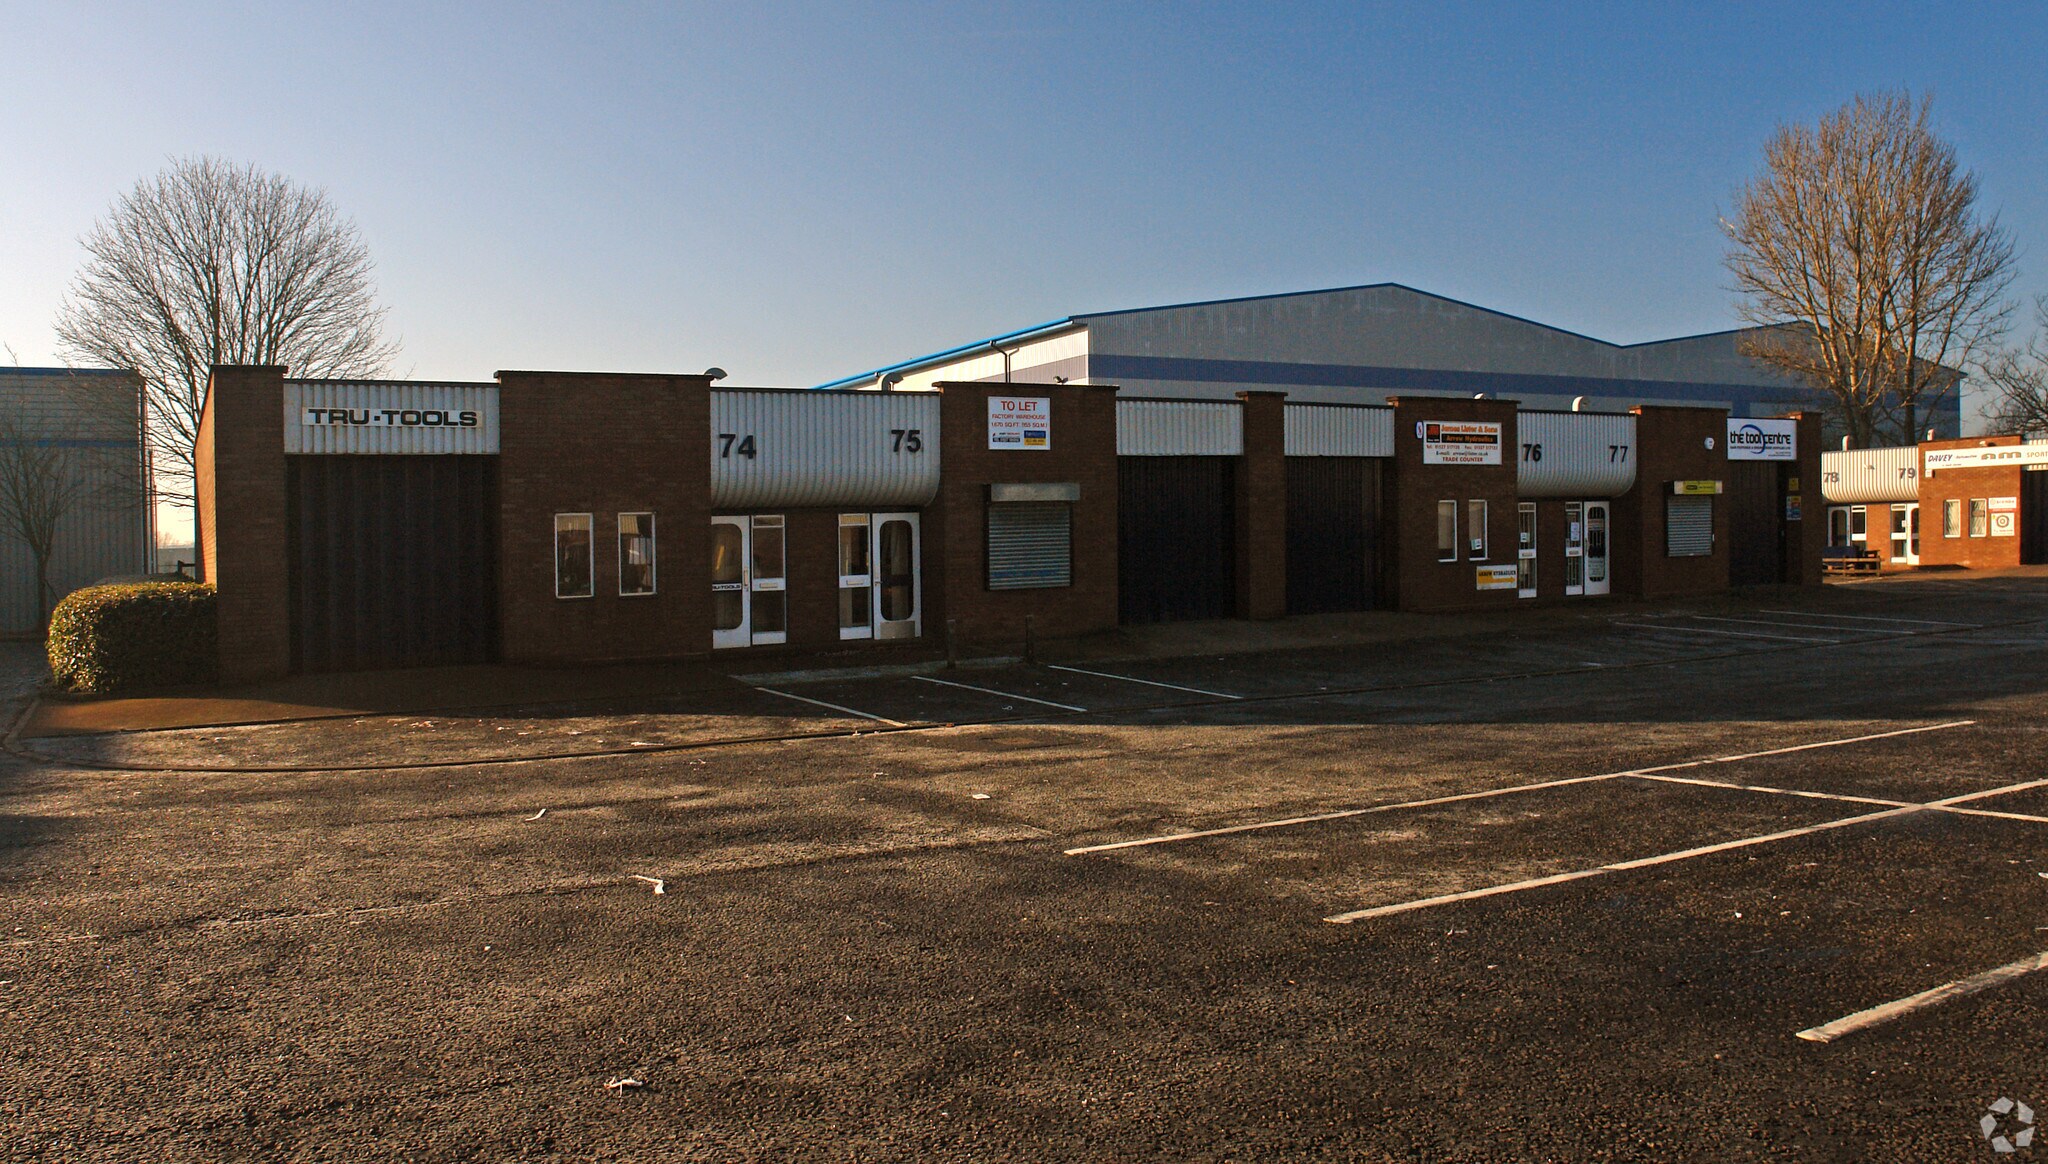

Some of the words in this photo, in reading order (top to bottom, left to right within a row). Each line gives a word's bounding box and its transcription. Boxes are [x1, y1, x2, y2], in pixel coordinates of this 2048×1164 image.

[1000, 400, 1015, 411] TO
[1018, 401, 1038, 411] LET
[890, 429, 922, 453] 75
[1729, 430, 1745, 444] the
[719, 433, 757, 459] 74
[1522, 443, 1542, 462] 76
[1609, 445, 1629, 463] 77
[1927, 454, 1953, 463] DAVEY
[1823, 472, 1839, 483] 78
[1897, 467, 1916, 479] 79
